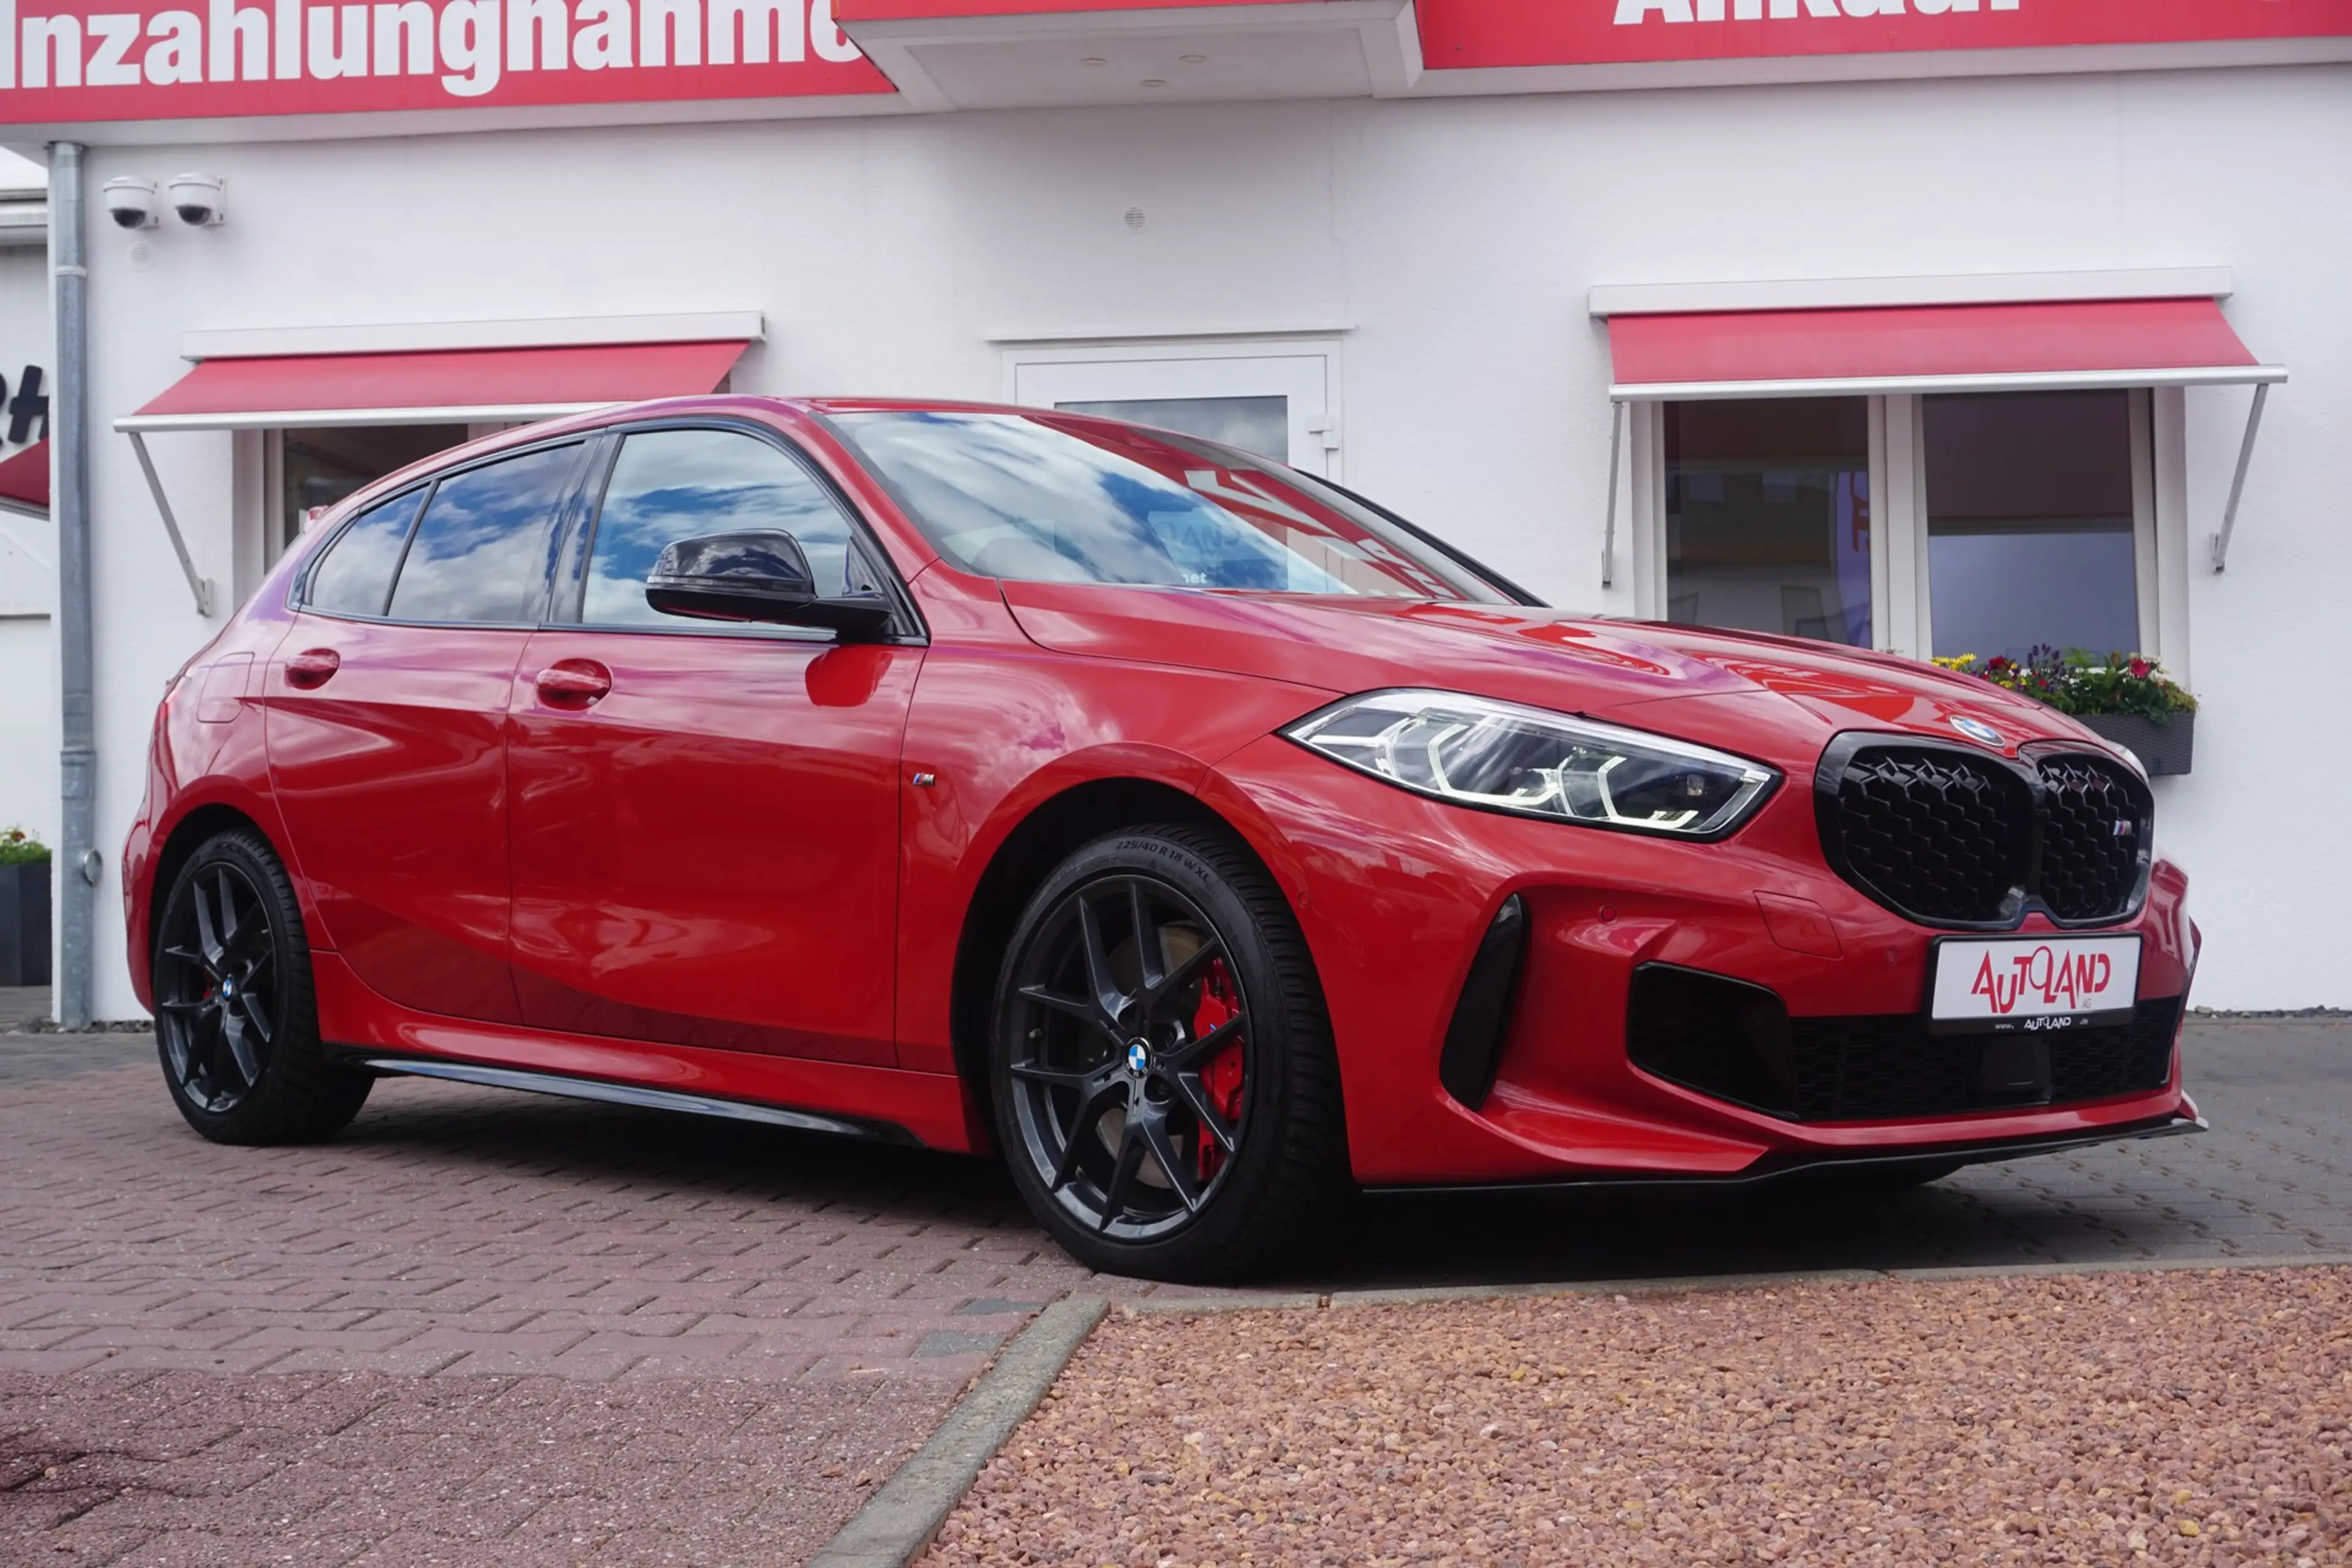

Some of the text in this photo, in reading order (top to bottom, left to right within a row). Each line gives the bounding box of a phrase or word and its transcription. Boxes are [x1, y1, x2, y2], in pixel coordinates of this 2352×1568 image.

[1116, 840, 1158, 853] 225/40
[1158, 847, 1168, 857] R
[1169, 850, 1184, 863] 18
[1195, 867, 1210, 883] XL
[1971, 945, 2111, 1014] AUTOLAND
[2024, 1016, 2071, 1030] AUTOLAND
